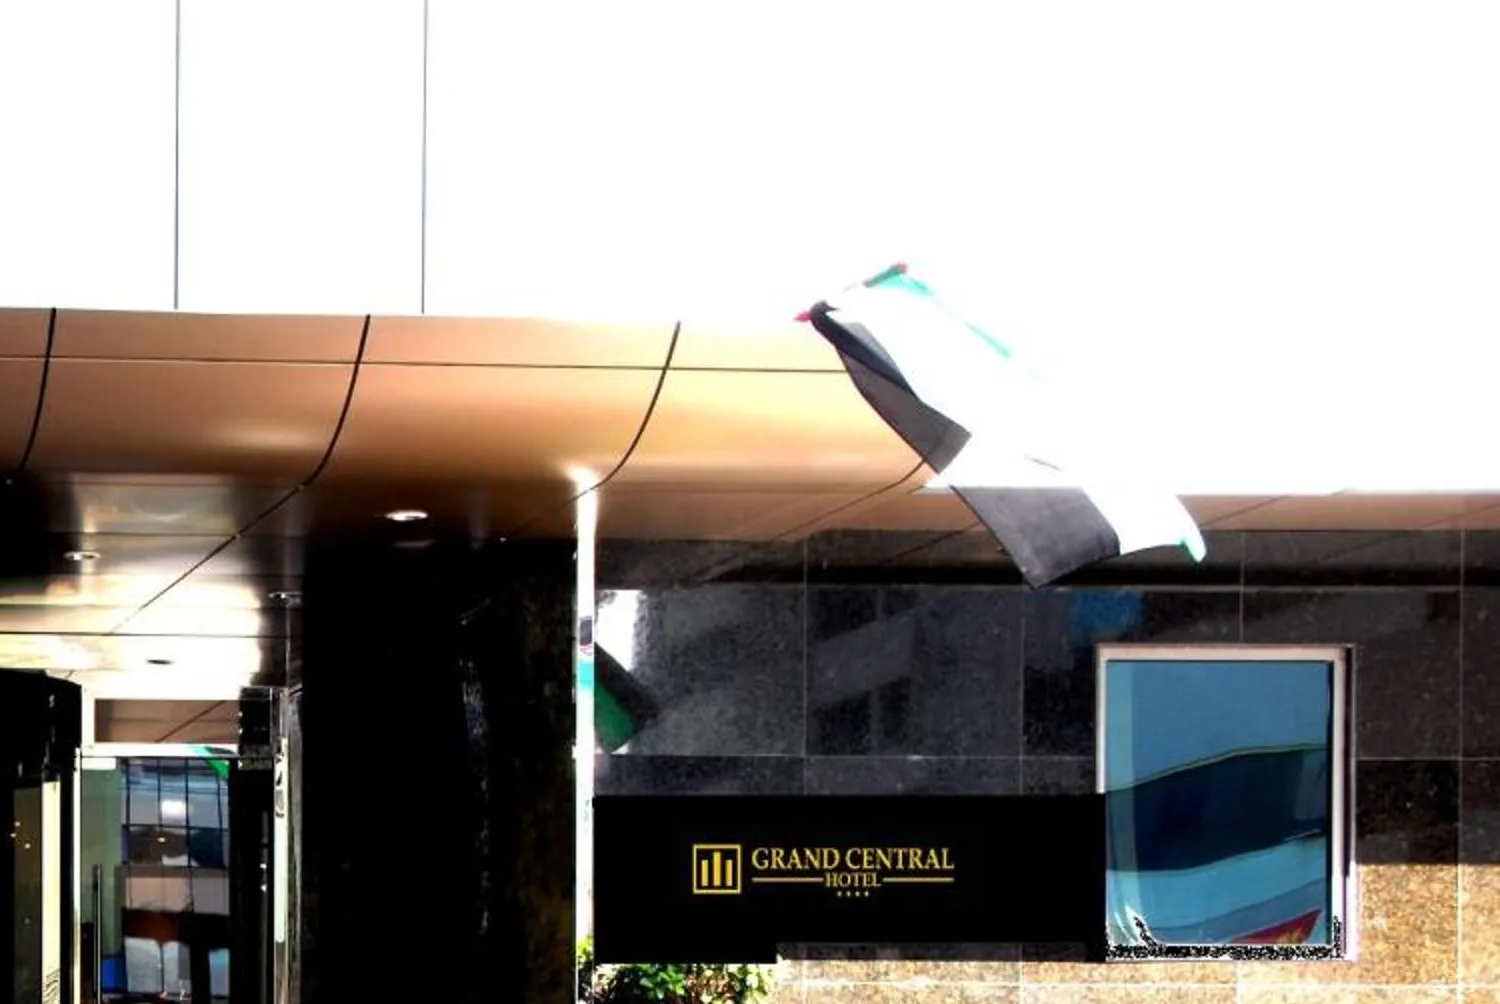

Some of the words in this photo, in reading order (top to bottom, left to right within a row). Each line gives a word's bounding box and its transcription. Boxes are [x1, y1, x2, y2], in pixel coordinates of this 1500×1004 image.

[752, 847, 840, 869] GRAND
[845, 847, 954, 869] CENTRAL
[825, 872, 881, 887] HOTEL
